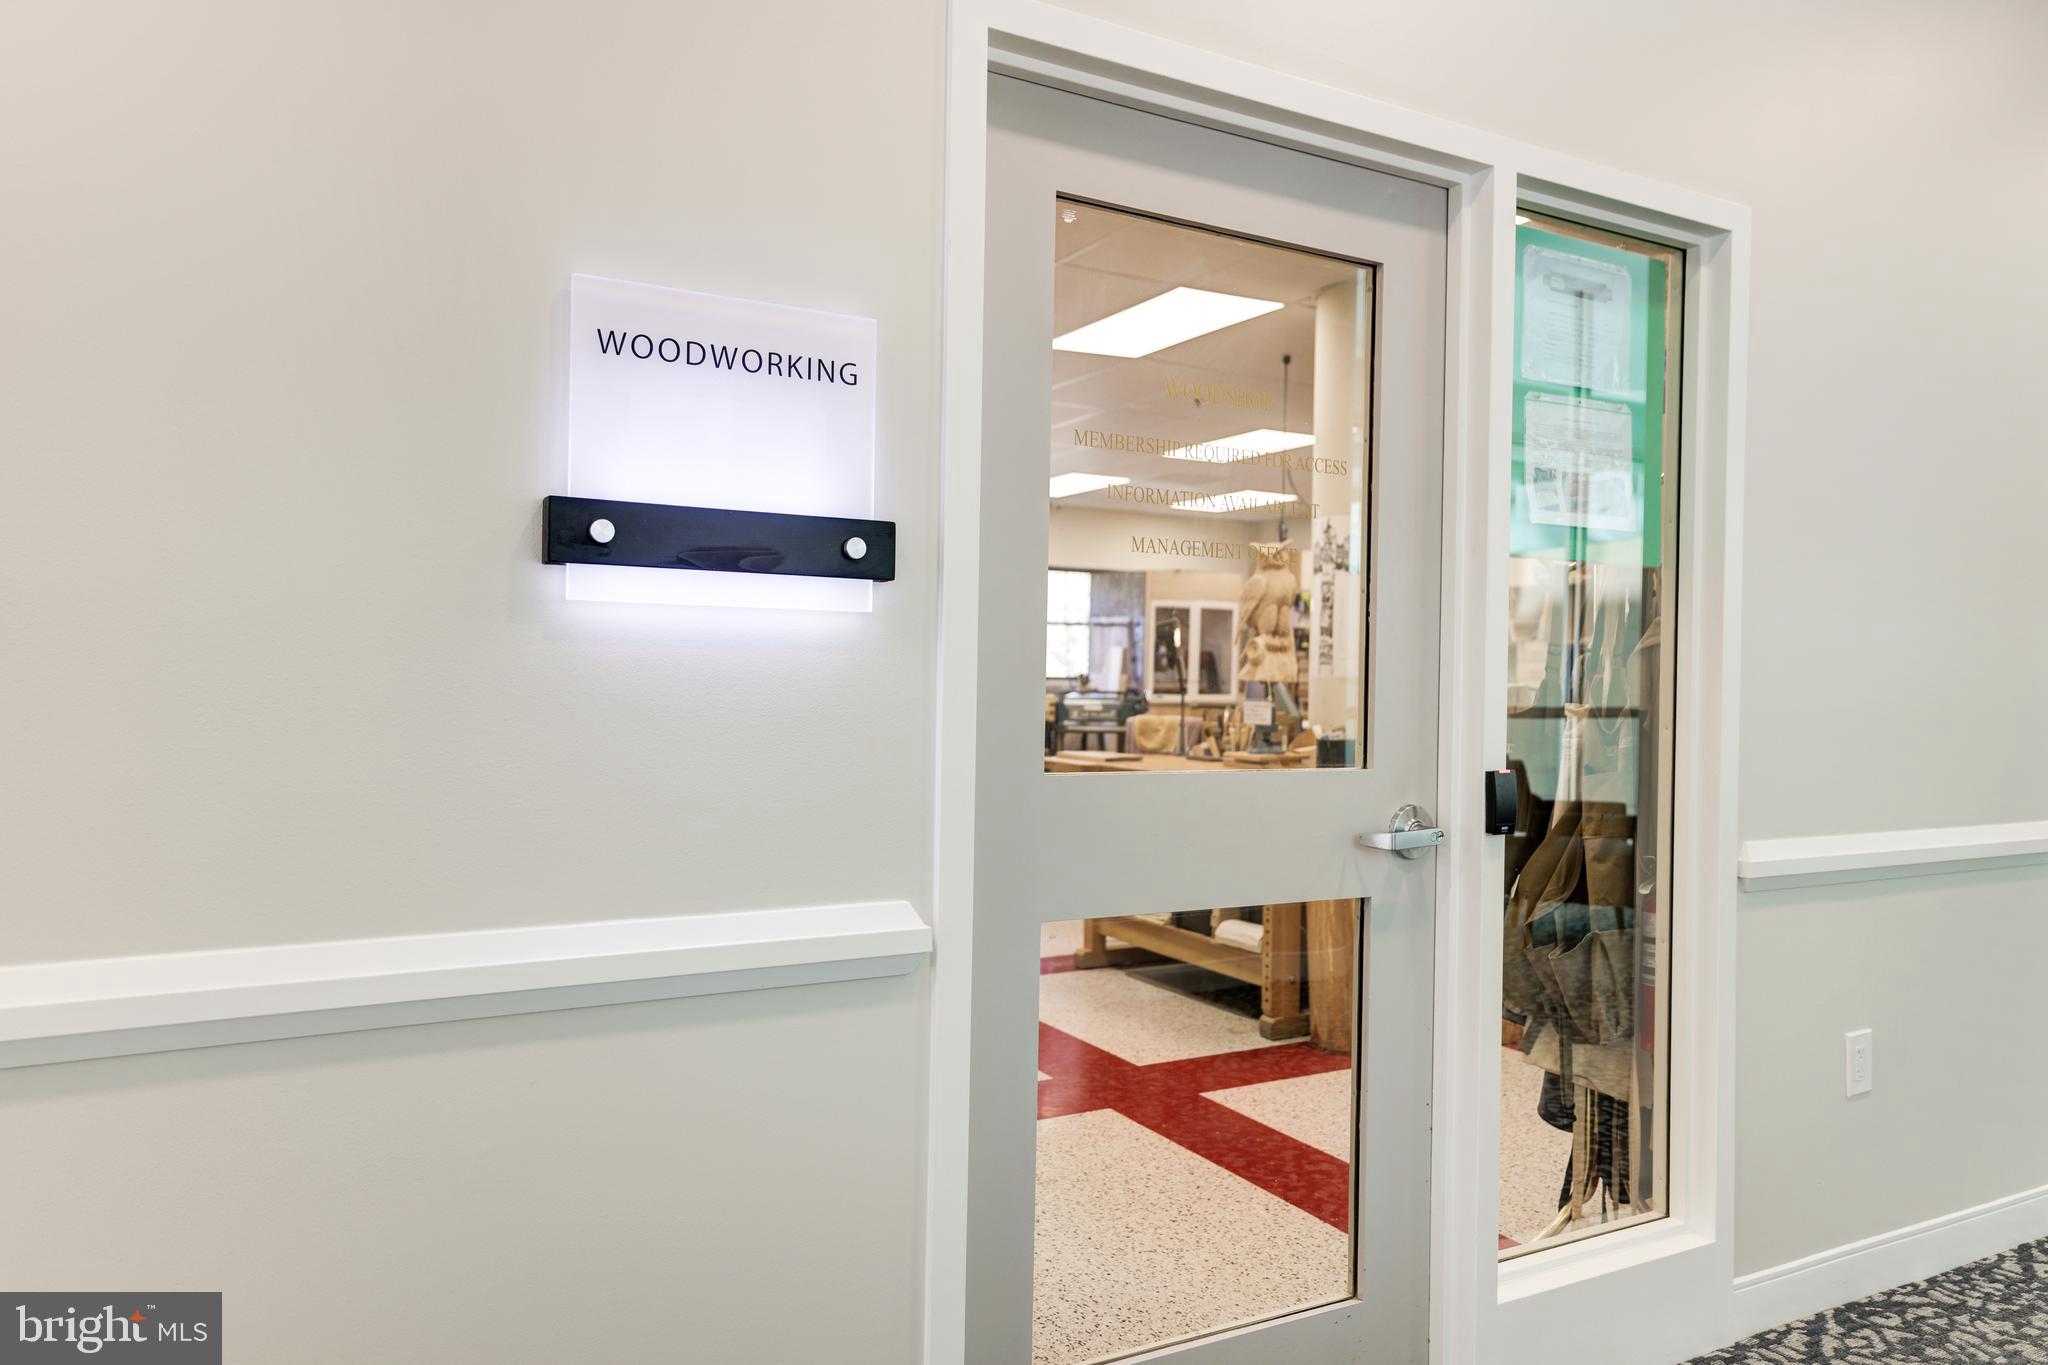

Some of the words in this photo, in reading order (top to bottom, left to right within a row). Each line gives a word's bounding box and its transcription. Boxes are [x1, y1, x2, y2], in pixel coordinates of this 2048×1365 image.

[597, 328, 858, 386] WOODWORKING
[1073, 429, 1181, 457] MEMBERSHIP
[1184, 442, 1261, 467] REQUIRED
[1264, 452, 1292, 470] FOR
[1296, 455, 1348, 476] ACCESS
[1107, 484, 1216, 510] INFORMATION
[1130, 535, 1243, 560] MANAGEMENT
[1247, 545, 1297, 564] OFFICE
